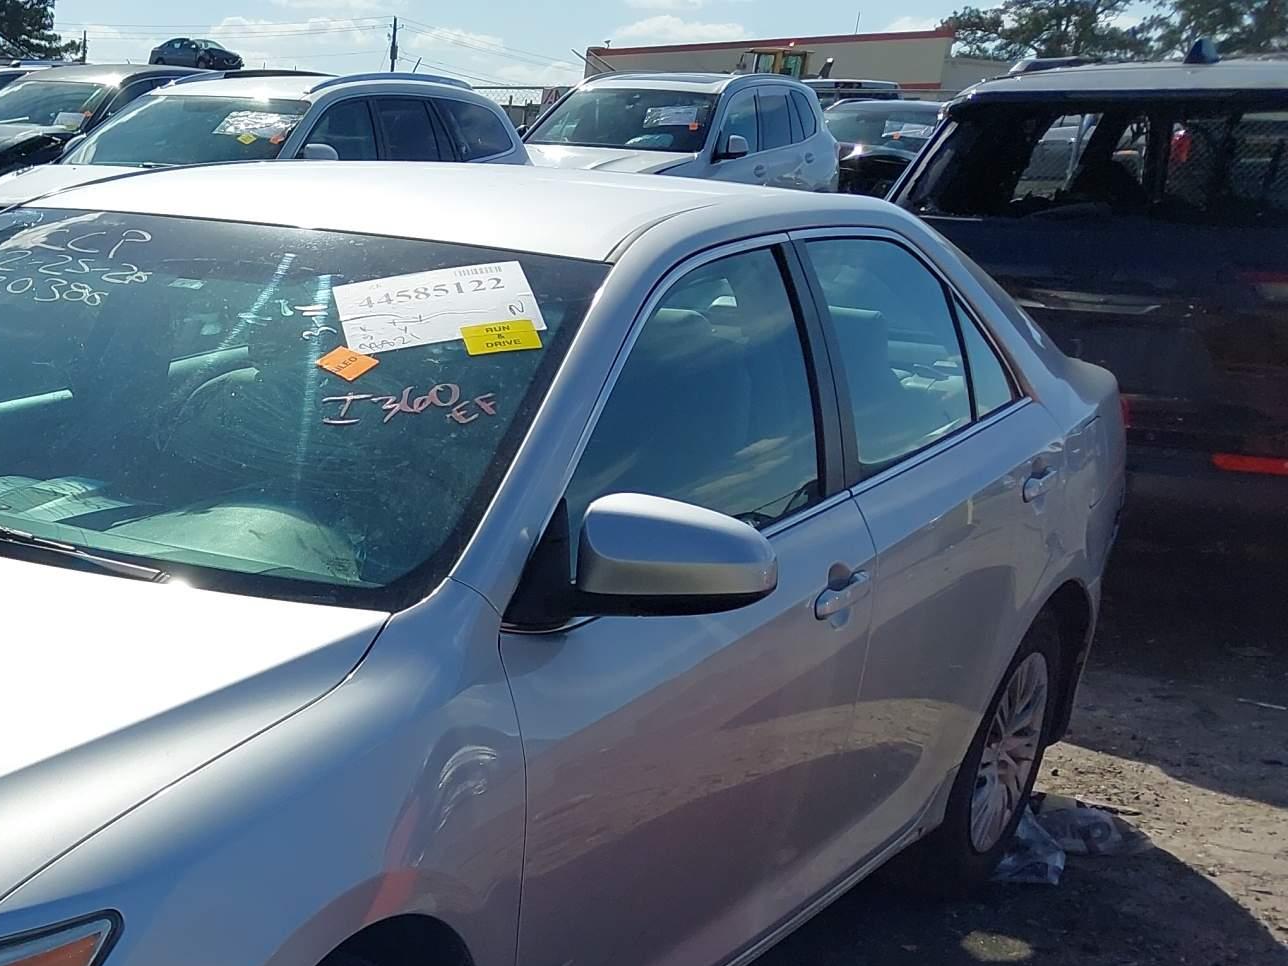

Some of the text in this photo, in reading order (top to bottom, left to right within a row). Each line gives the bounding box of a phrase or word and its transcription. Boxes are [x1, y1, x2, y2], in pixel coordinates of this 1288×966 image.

[358, 277, 505, 308] 44585122
[485, 325, 511, 334] RUN
[486, 339, 522, 348] DRIVE
